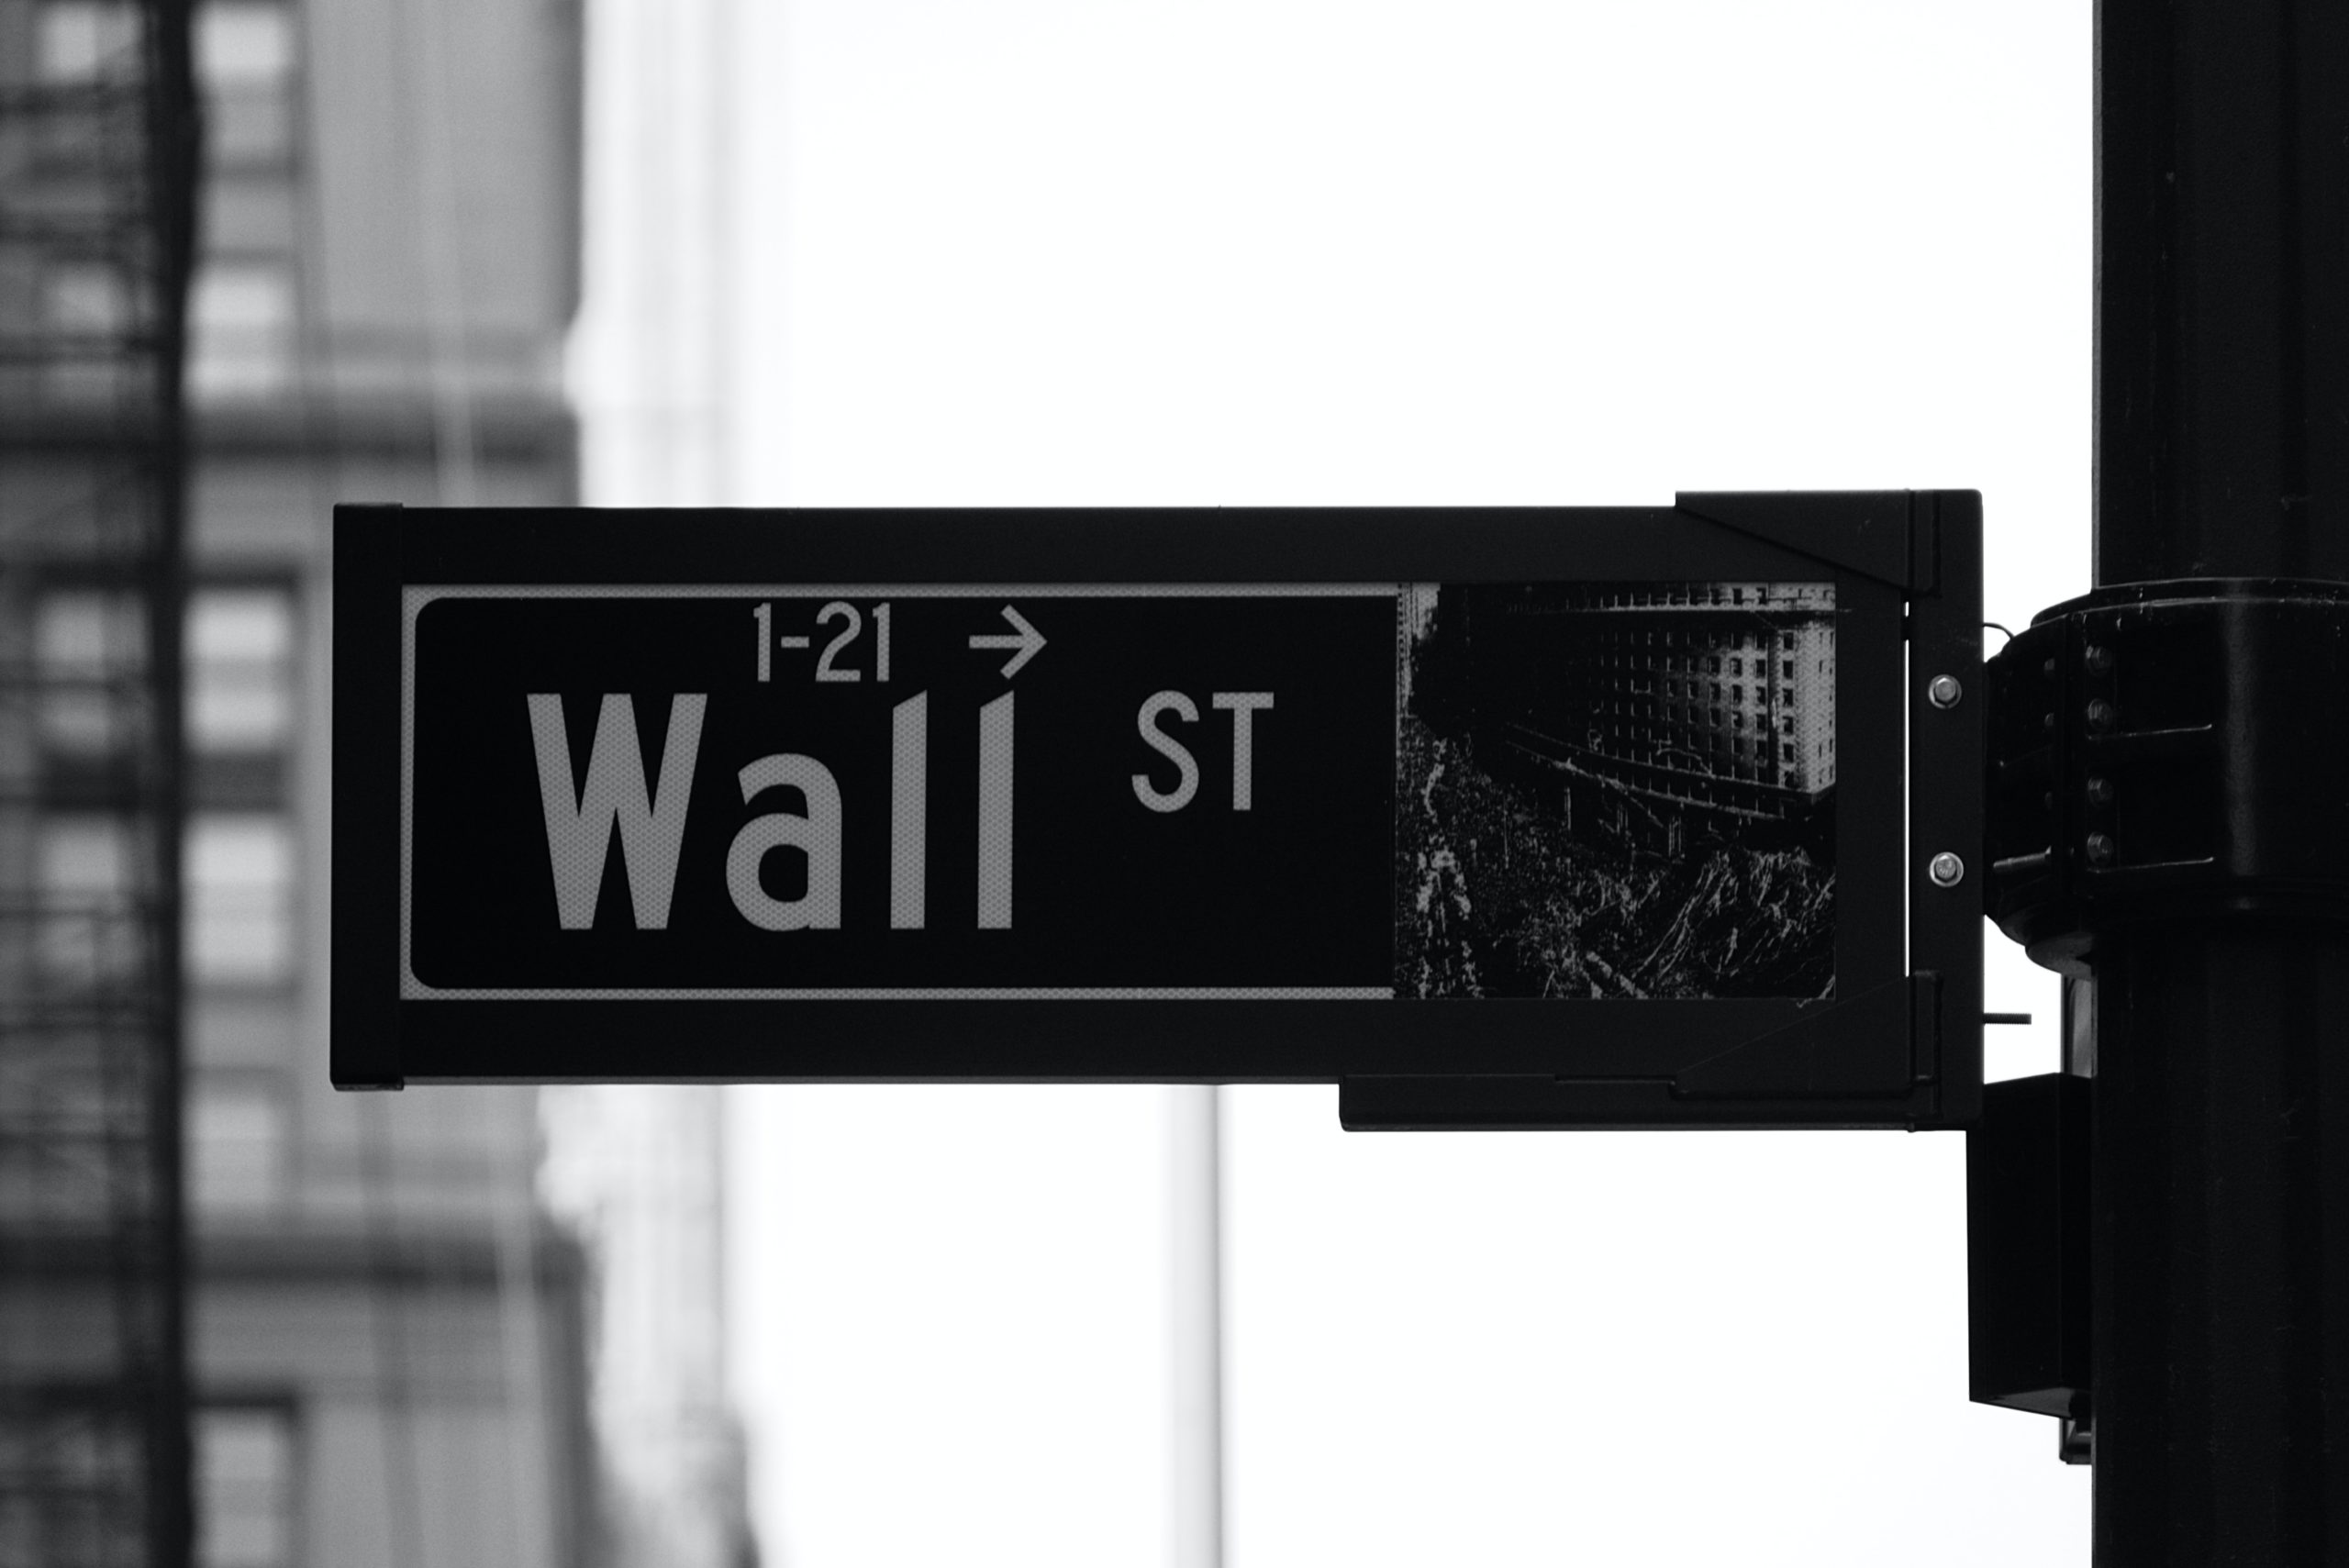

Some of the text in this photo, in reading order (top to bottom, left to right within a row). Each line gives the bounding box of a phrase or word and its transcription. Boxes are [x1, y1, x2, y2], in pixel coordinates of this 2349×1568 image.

[752, 601, 891, 682] 1-21
[527, 690, 1275, 931] Wall ST
